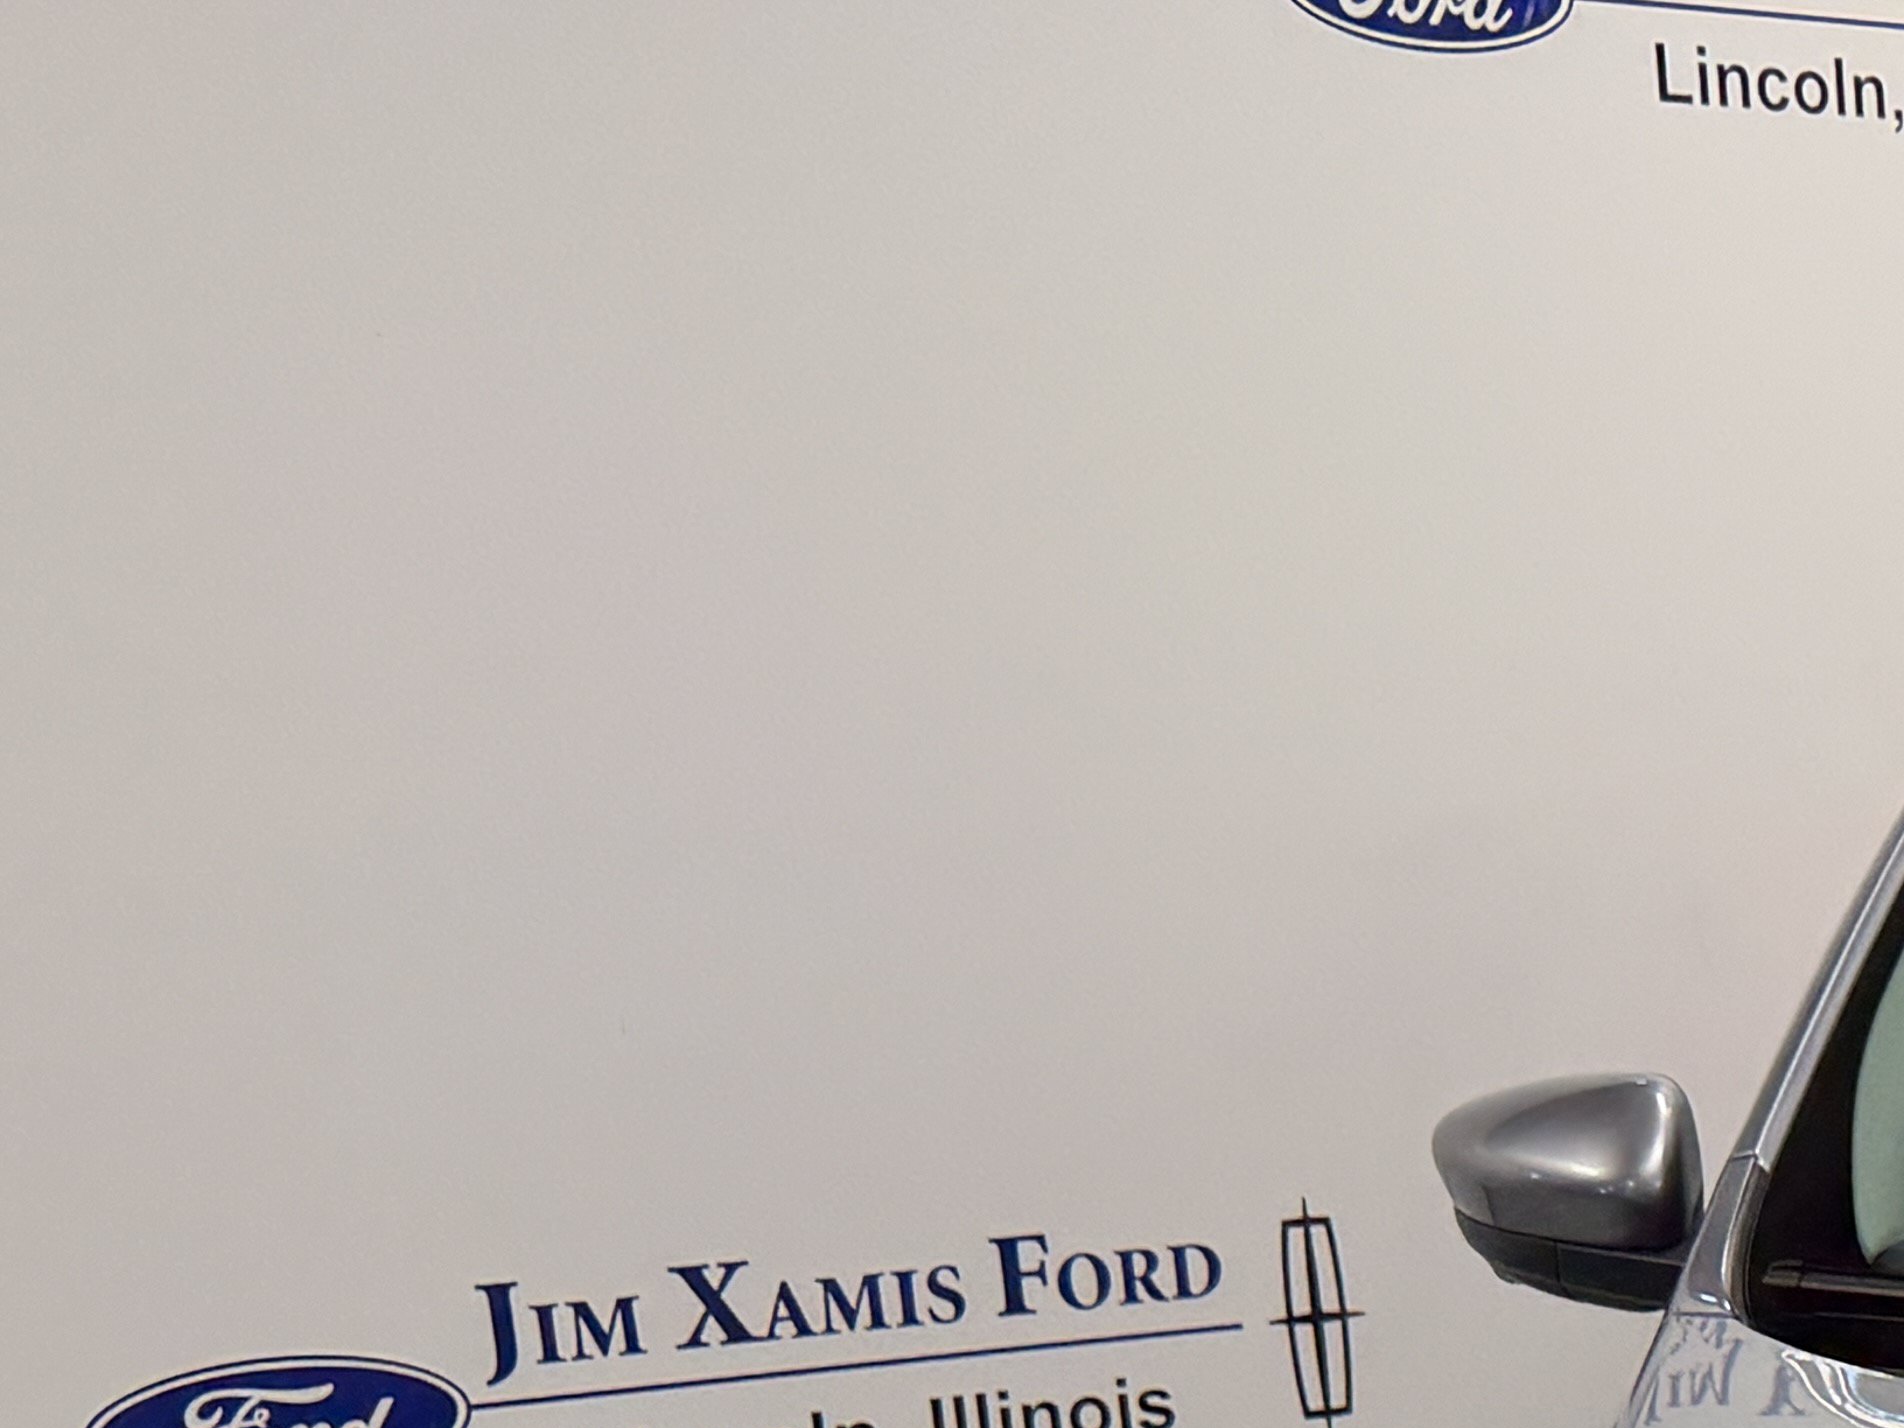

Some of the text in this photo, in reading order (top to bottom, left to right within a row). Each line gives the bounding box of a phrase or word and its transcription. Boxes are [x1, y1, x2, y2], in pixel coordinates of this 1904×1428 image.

[1655, 42, 1904, 133] Lincoln,
[474, 1234, 1222, 1387] JIM XAMIS FORD
